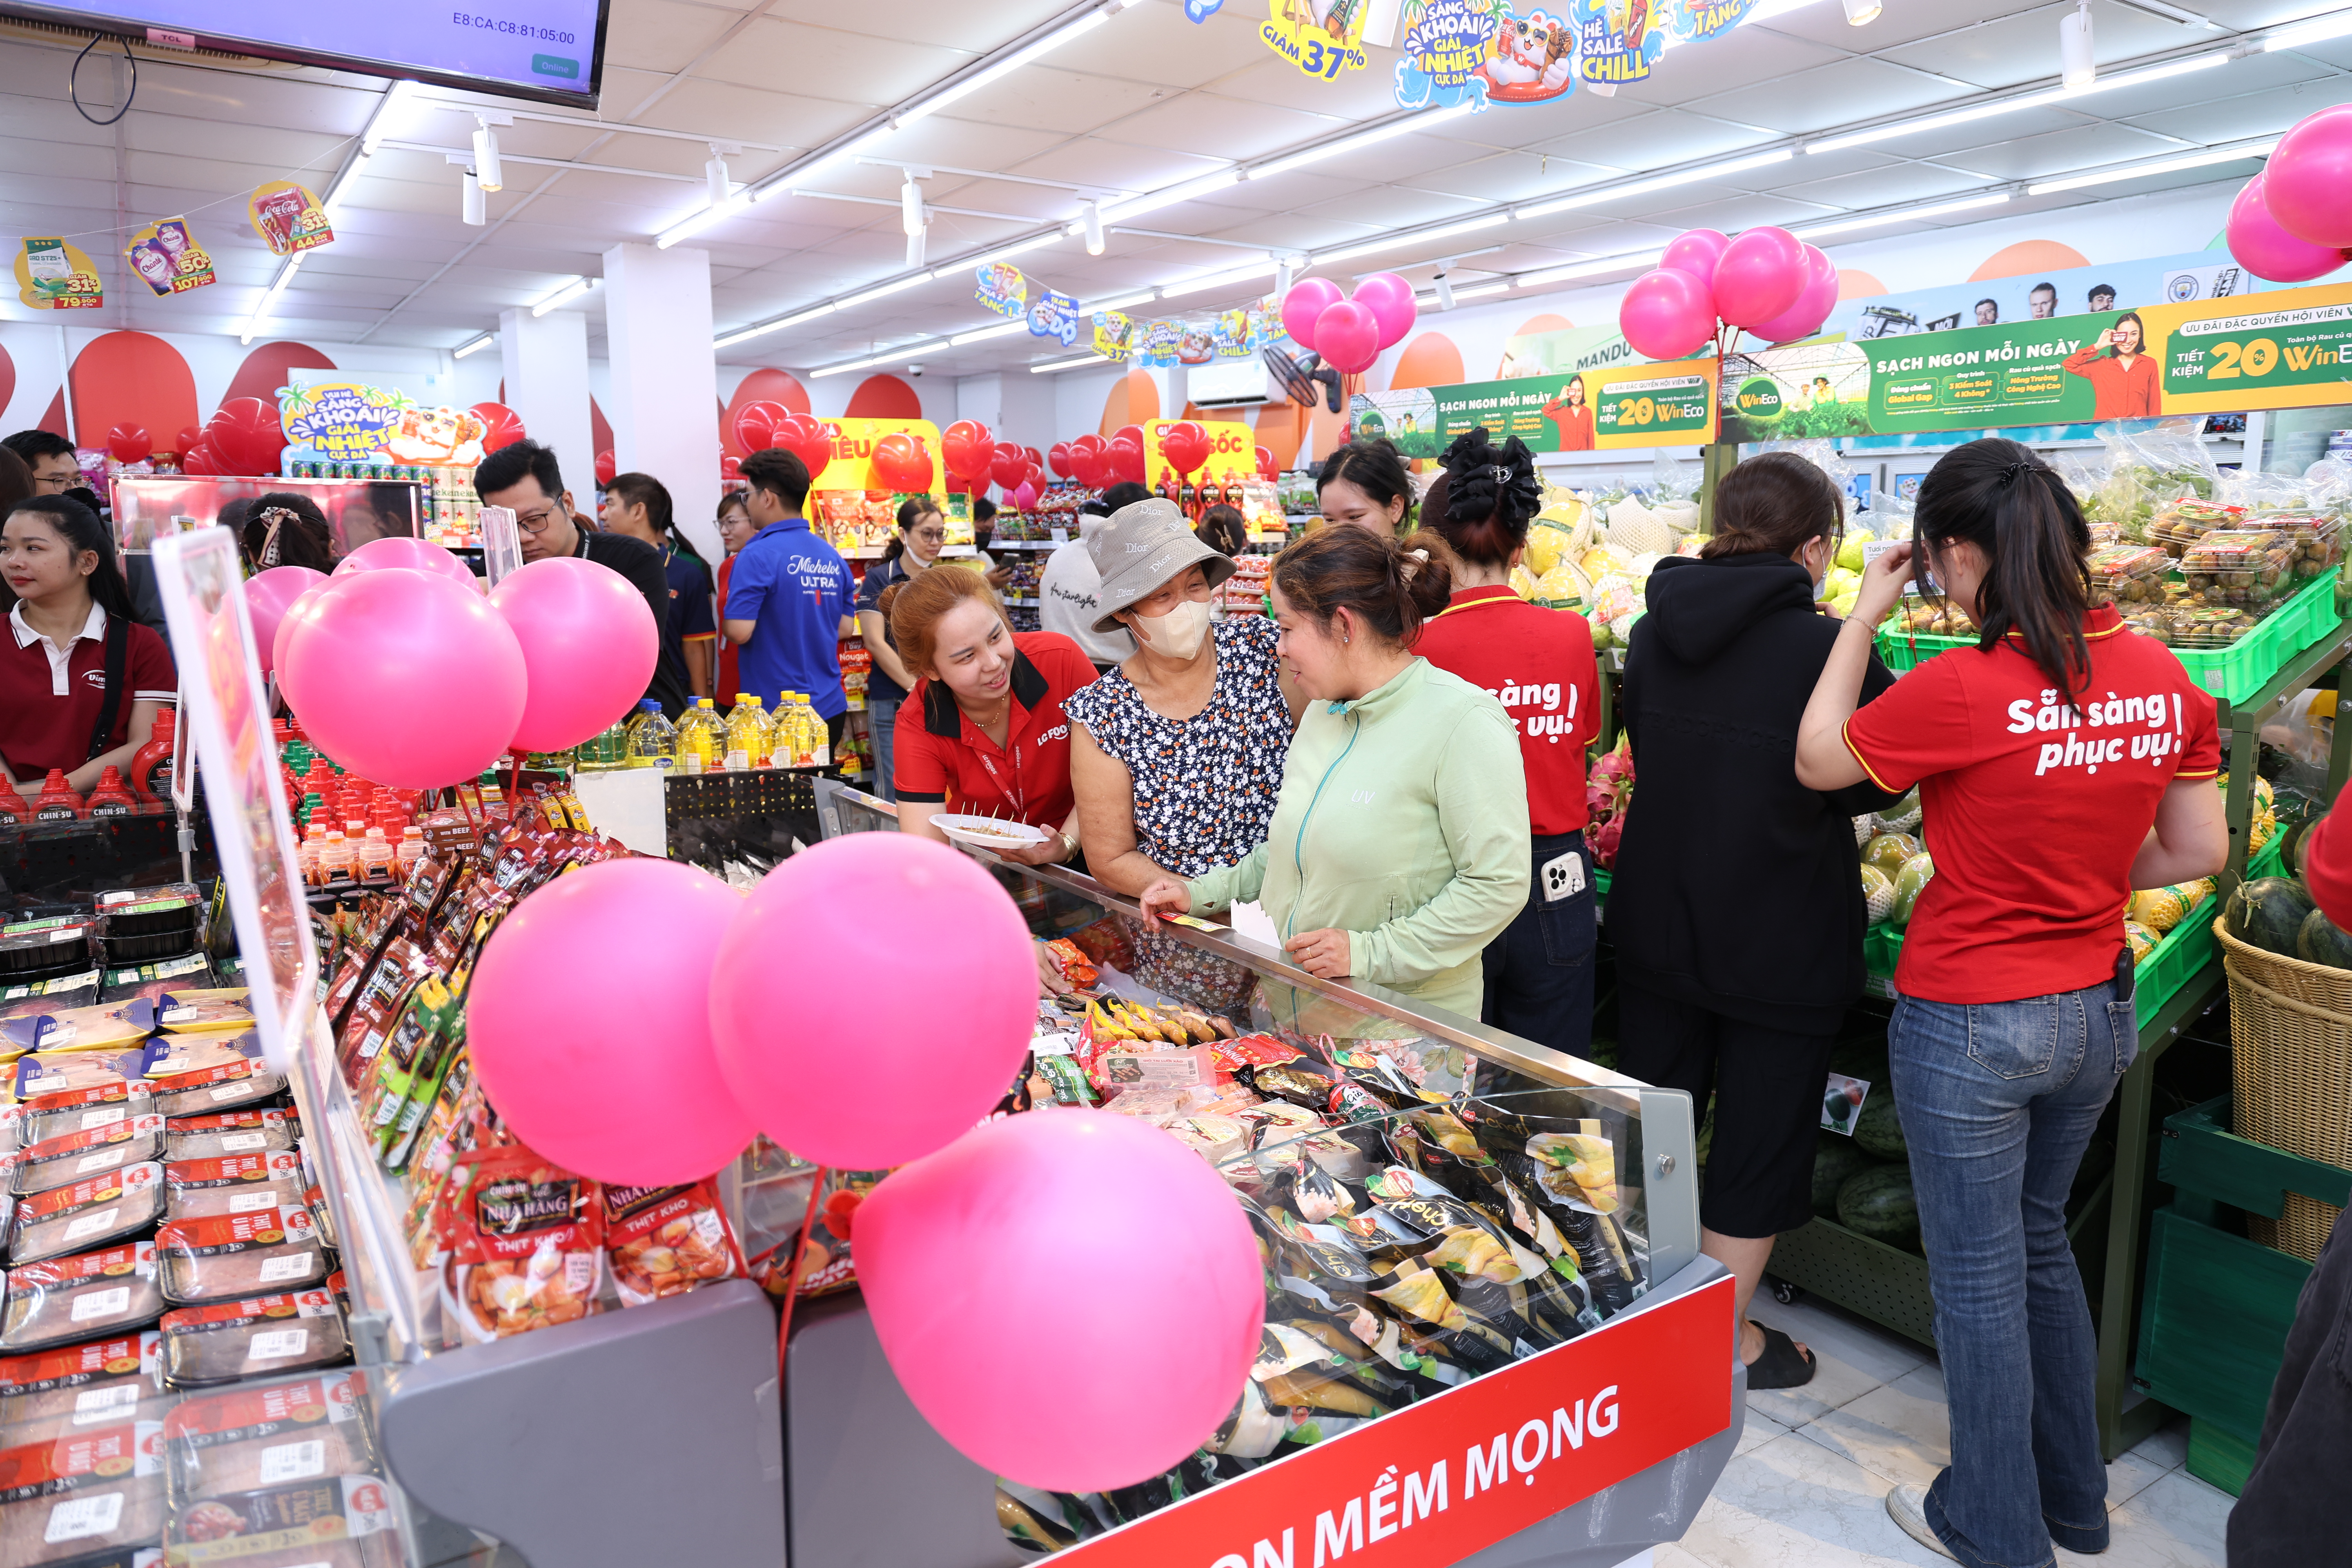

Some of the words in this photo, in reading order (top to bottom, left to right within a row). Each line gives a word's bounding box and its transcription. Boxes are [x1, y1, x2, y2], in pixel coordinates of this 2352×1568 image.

[1428, 0, 1464, 20] SẢNG
[1695, 0, 1741, 35] TẶNG
[453, 12, 574, 44] E8:CA:C8:81:05:00
[1420, 13, 1479, 43] KHOÁI
[1584, 18, 1603, 38] HÈ
[1629, 13, 1644, 38] STING
[161, 34, 181, 43] TCL
[1434, 34, 1461, 53] GIẢI
[1583, 34, 1623, 55] SALE
[1263, 25, 1300, 61] GIẢM
[1302, 40, 1365, 78] 37%
[1425, 42, 1484, 73] NHIỆT
[542, 62, 569, 74] Online
[1582, 50, 1649, 80] CHILL
[265, 200, 299, 214] Coca-Cola
[163, 234, 180, 243] Chanté
[142, 256, 162, 272] Chanté
[180, 256, 210, 273] 50%
[67, 279, 96, 292] 31%
[978, 285, 995, 298] MUA
[1007, 306, 1013, 318] 1
[2186, 323, 2200, 333] ƯU
[2203, 320, 2222, 331] ĐÃI
[2225, 319, 2247, 330] ĐẶC
[2250, 312, 2288, 326] QUYỀN
[2292, 311, 2312, 323] HỘI
[2316, 307, 2343, 319] VIÊN
[1217, 338, 1237, 347] SALE
[2306, 335, 2317, 343] bộ
[1218, 344, 1250, 356] CHILL
[1576, 340, 1632, 370] MANDU
[1876, 356, 1924, 376] SẠCH
[1927, 350, 1980, 368] NGON
[1985, 340, 2021, 363] MỖI
[2026, 338, 2081, 358] NGÀY
[2176, 348, 2205, 363] TIẾT
[2282, 343, 2352, 372] WinE
[2207, 338, 2279, 380] 20
[2045, 363, 2062, 372] sạch
[2171, 364, 2204, 378] KIỆM
[1954, 380, 1974, 389] Kiểm
[1974, 379, 1993, 388] Soát
[2010, 376, 2030, 385] Nông
[2030, 373, 2059, 384] Trường
[340, 390, 352, 398] HÈ
[1890, 384, 1910, 394] Đúng
[1910, 382, 1931, 391] chuẩn
[2006, 385, 2024, 394] Công
[2024, 383, 2046, 393] Nghệ
[316, 395, 363, 413] SẢNG
[1439, 400, 1466, 415] SẠCH
[1468, 397, 1498, 410] NGON
[1499, 391, 1520, 407] MỖI
[1521, 391, 1552, 405] NGÀY
[1739, 393, 1778, 408] WinEco
[1887, 394, 1914, 404] Global
[1915, 393, 1933, 403] Gap
[1601, 402, 1617, 413] TIẾT
[1617, 397, 1655, 426] 20
[1655, 403, 1705, 423] WinEco
[307, 405, 381, 430] KHOÁI
[1599, 414, 1617, 424] KIỆM
[326, 421, 360, 436] GIẢI
[315, 428, 390, 452] NHIỆT
[1139, 504, 1163, 516] Dior
[1125, 543, 1148, 553] Dior
[1149, 554, 1172, 573] Dior
[800, 575, 835, 588] ULTRA
[1115, 588, 1136, 598] Dior
[839, 652, 869, 661] Nougat
[2006, 688, 2081, 734] Sẵn
[2087, 691, 2166, 728] sàng
[2034, 732, 2125, 776] phục
[985, 759, 997, 775] FOODS
[1351, 789, 1376, 804] UV
[38, 811, 72, 820] CHIN-SU
[93, 807, 126, 816] CHIN-SU
[1214, 1044, 1248, 1066] WINNER
[1347, 1089, 1364, 1103] Giò
[1463, 1112, 1475, 1120] MEAT
[1486, 1117, 1524, 1135] Chef
[524, 1195, 568, 1216] HÀNG
[1399, 1198, 1448, 1226] Chef
[251, 1213, 272, 1230] THỊT
[294, 1213, 307, 1228] MEAT
[625, 1212, 657, 1233] THỊT
[660, 1198, 689, 1218] KHO
[297, 1228, 310, 1240] Deli
[494, 1238, 530, 1253] THỊT
[1313, 1465, 1449, 1568] MỀM
[1464, 1384, 1620, 1501] MỌNG
